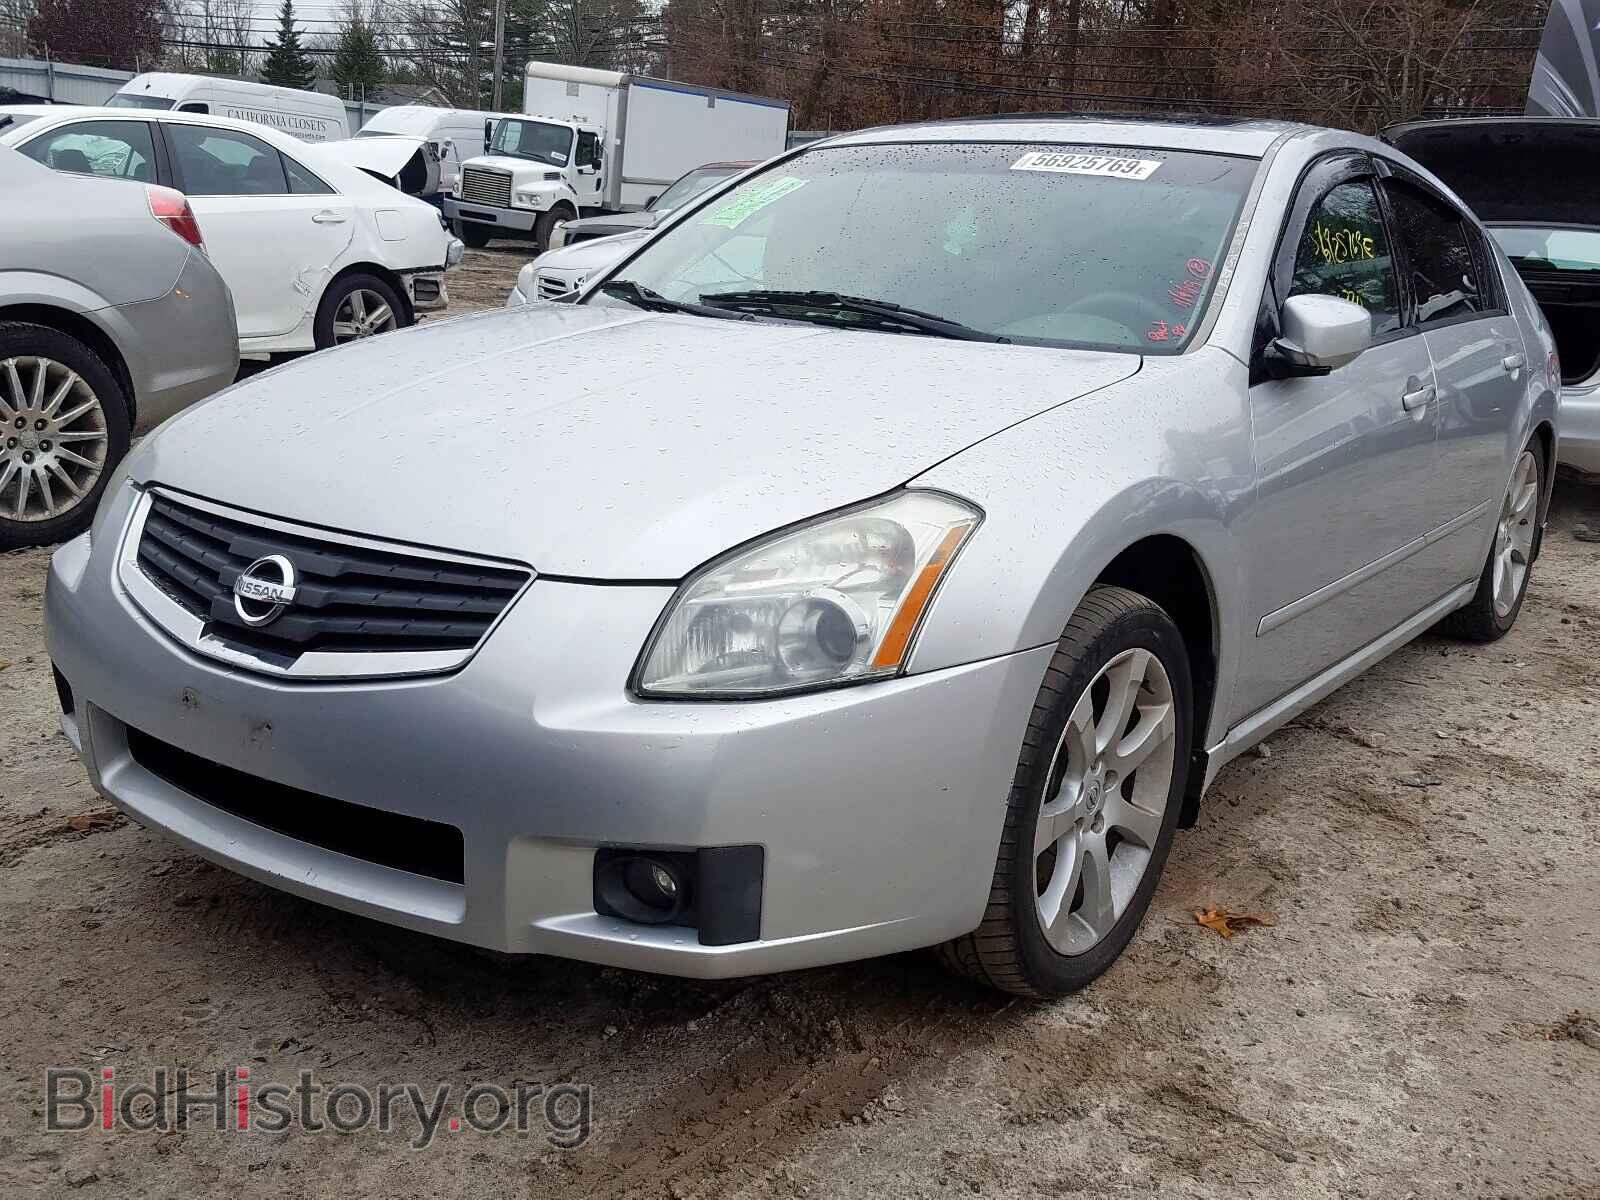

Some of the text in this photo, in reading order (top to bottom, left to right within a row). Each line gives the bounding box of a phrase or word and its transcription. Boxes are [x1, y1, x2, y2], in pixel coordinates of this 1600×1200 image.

[227, 109, 327, 132] CALIFORNIA CLOSETS
[233, 577, 284, 601] NISSAN
